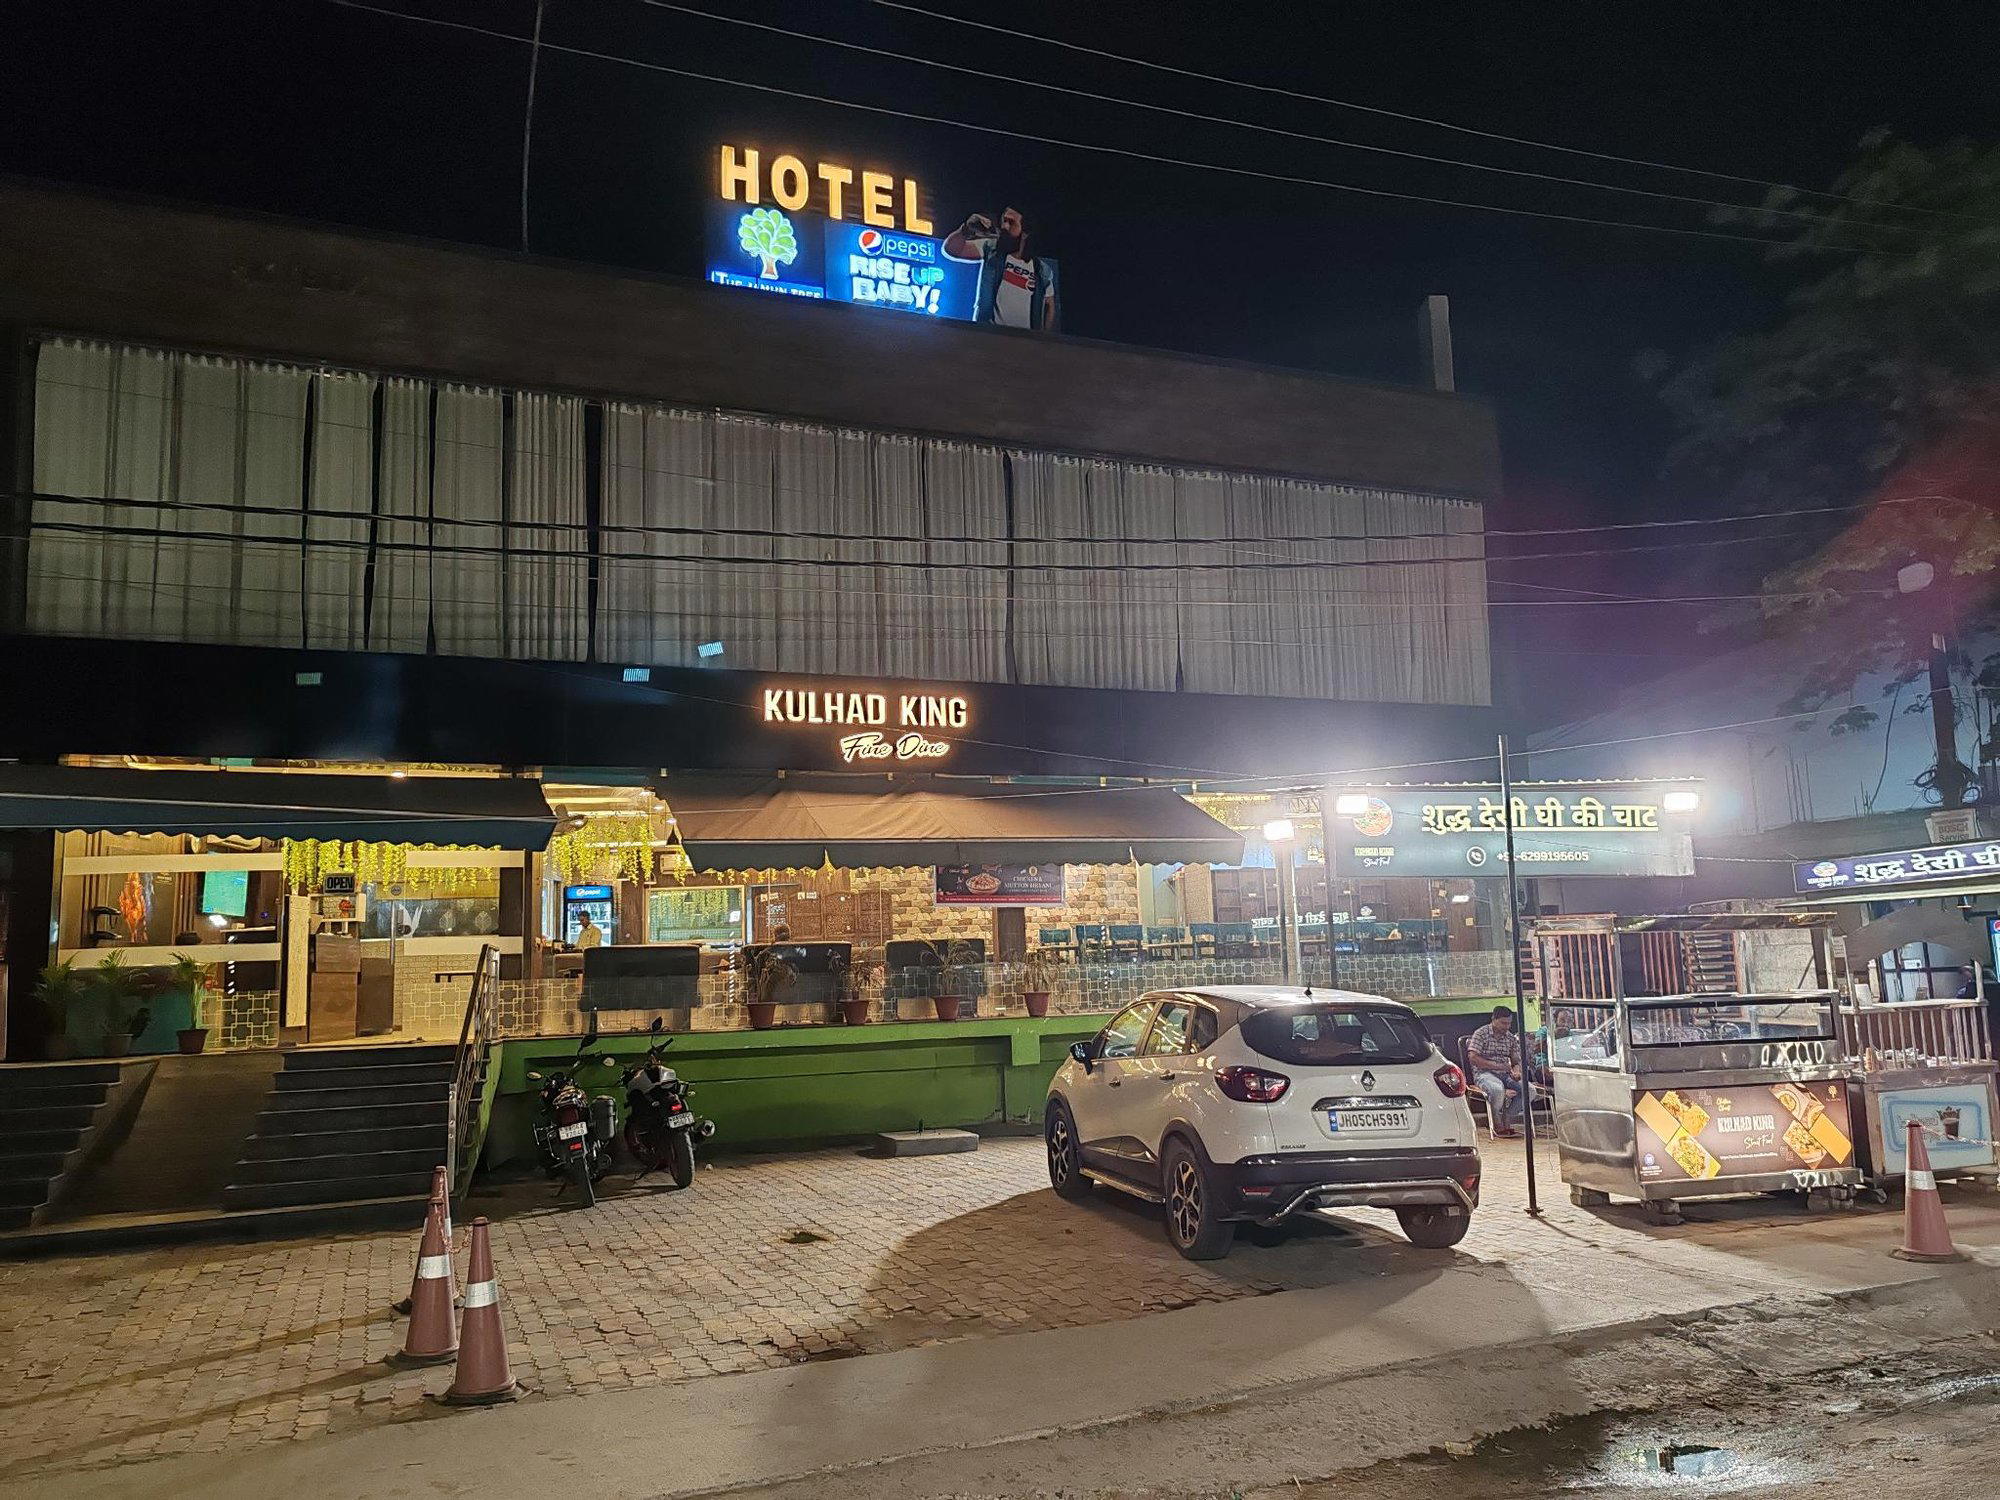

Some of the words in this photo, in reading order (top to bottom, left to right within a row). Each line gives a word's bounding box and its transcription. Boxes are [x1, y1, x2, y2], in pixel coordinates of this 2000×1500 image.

[721, 145, 933, 235] HOTEL
[886, 239, 931, 258] pepsi
[849, 254, 911, 285] RISE
[911, 266, 945, 287] UP
[1005, 262, 1038, 280] PEPS
[852, 276, 941, 314] BABY!
[764, 689, 886, 725] KULHAD
[900, 695, 967, 728] KING
[841, 732, 893, 762] Fine
[897, 732, 950, 760] Dine
[1421, 803, 1472, 835] शुद्ध
[1534, 797, 1565, 828] घी
[1570, 797, 1605, 828] की
[1610, 804, 1658, 828] चाट
[1497, 851, 1589, 863] +9-6299195605
[1854, 860, 1906, 882] शुद्ध
[1911, 849, 1967, 874] देसी
[326, 876, 353, 889] OPEN
[1338, 1113, 1406, 1128] JH05CH5991
